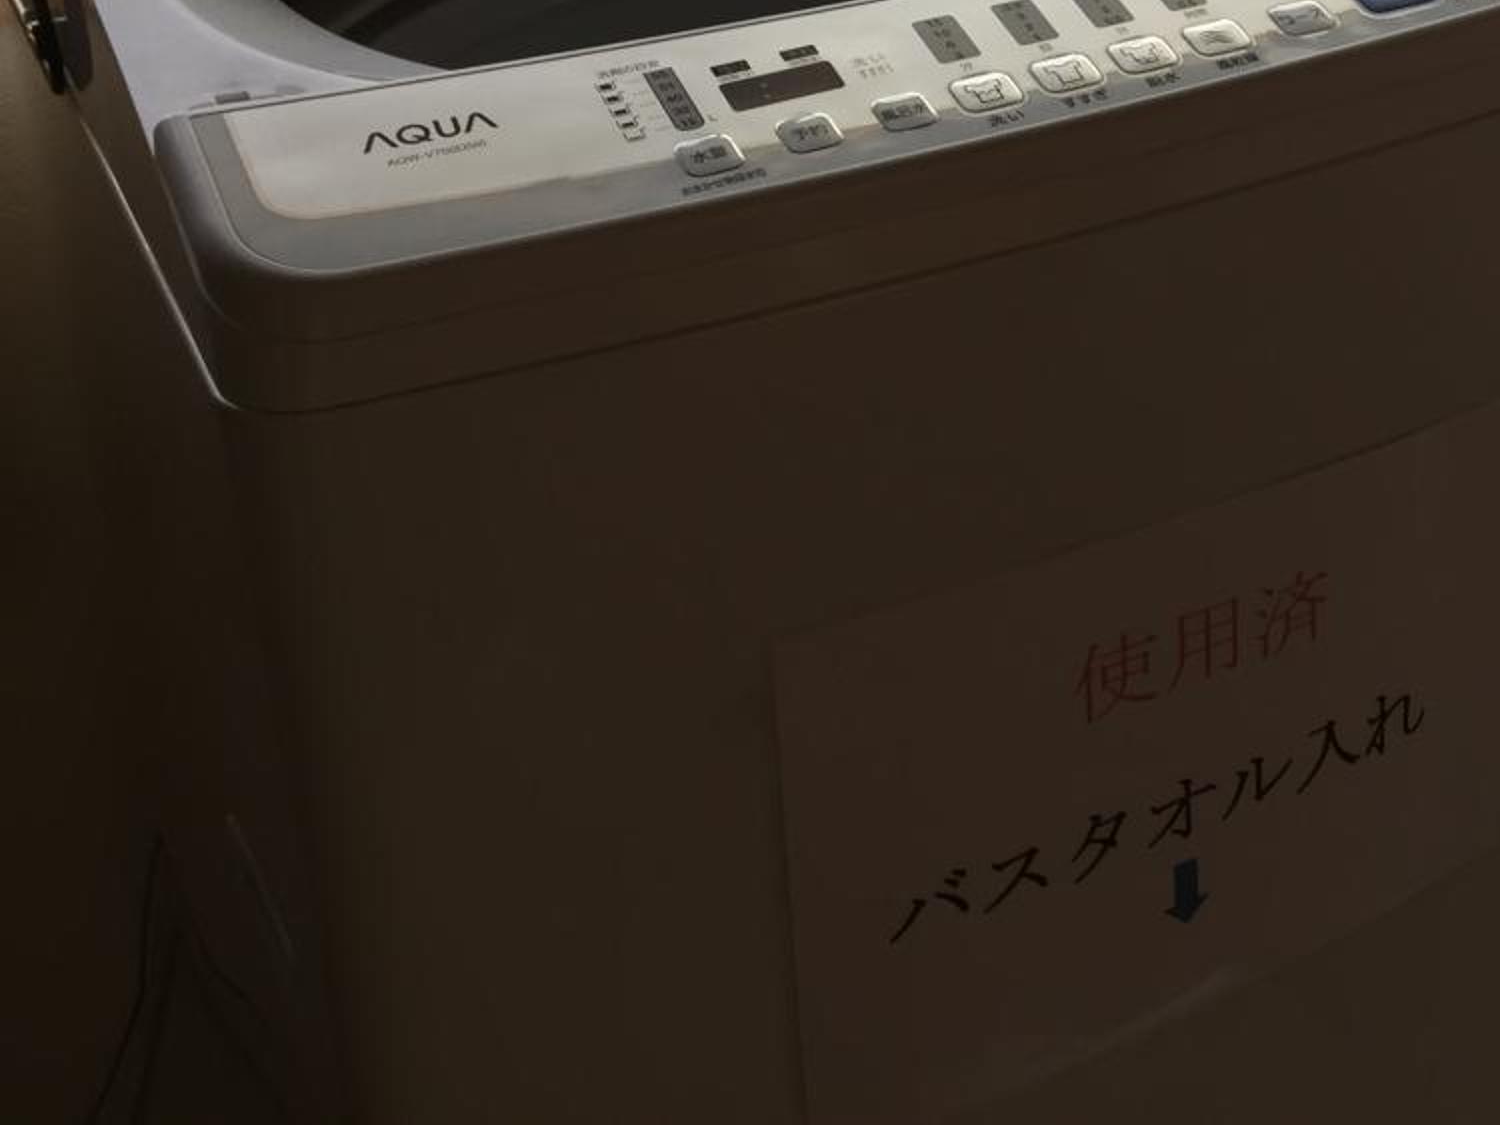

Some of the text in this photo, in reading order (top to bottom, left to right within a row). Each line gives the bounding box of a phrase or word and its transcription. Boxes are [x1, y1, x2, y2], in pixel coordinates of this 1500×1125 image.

[364, 111, 499, 155] AQUA
[1073, 571, 1329, 724] 使用済
[889, 694, 1426, 945] バスタオル入れ
